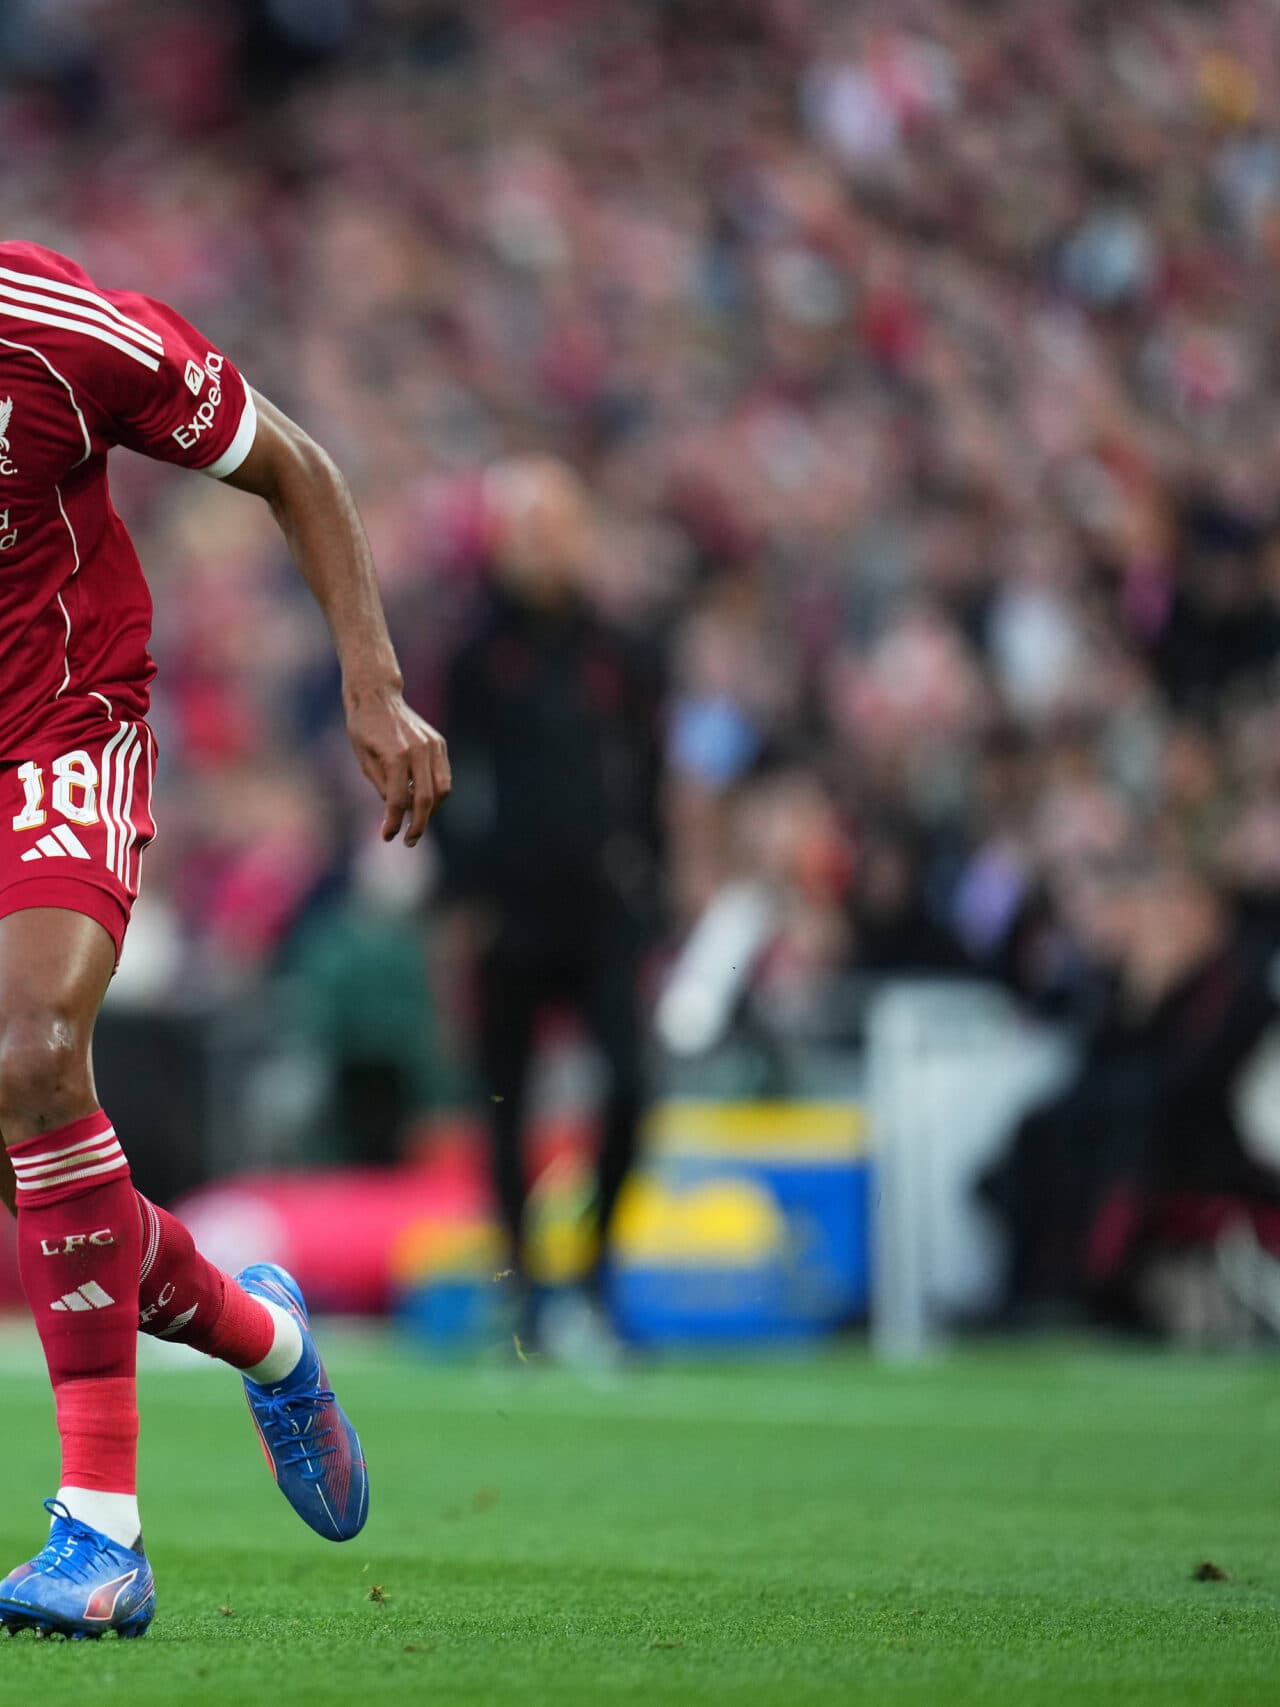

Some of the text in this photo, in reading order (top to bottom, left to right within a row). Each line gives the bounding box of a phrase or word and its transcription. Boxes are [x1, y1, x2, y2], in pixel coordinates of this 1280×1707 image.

[172, 351, 224, 449] Expea
[12, 750, 100, 832] 18
[40, 1228, 114, 1256] LFC
[139, 1282, 176, 1324] FC
